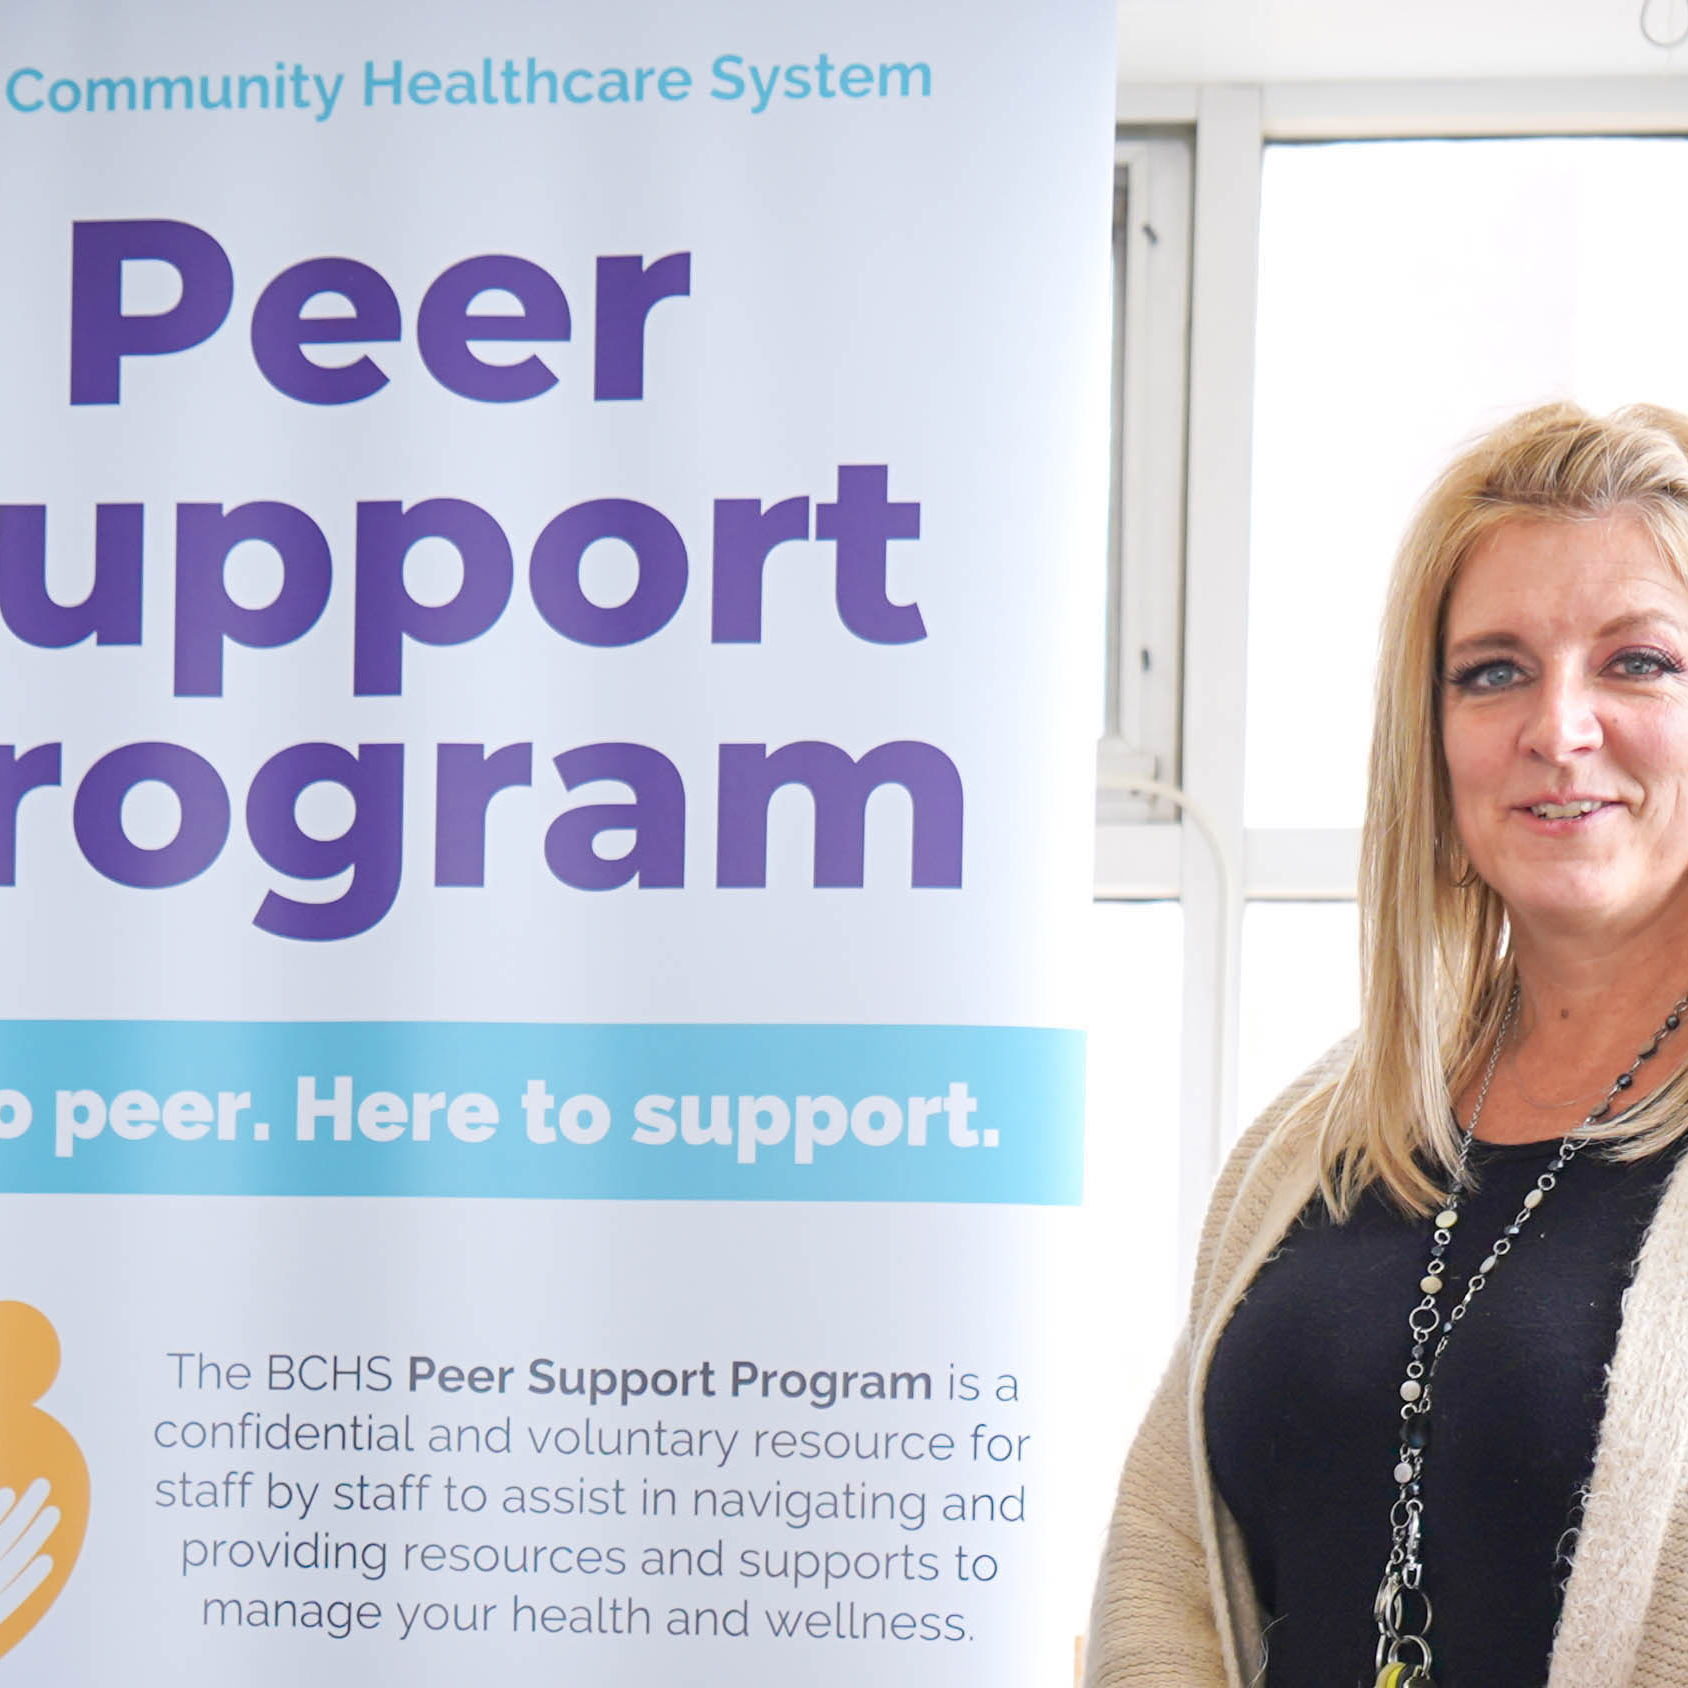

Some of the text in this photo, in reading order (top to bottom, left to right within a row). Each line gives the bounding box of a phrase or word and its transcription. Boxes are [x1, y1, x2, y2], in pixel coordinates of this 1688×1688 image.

[6, 62, 345, 123] Community
[364, 56, 693, 107] Healthcare
[711, 53, 932, 115] System
[70, 218, 691, 407] Peer
[54, 1089, 270, 1158] peer.
[295, 1075, 498, 1143] Here
[529, 1080, 612, 1145] to
[631, 1082, 1000, 1165] support.
[166, 1351, 1020, 1409] The BCHS Peer Support Program is a
[154, 1411, 1031, 1469] confidential and voluntary resource for
[154, 1471, 1026, 1532] staff by staff to assist in navigating and
[182, 1531, 999, 1590] providing resources and supports to
[202, 1595, 975, 1643] manage your health and wellness.
